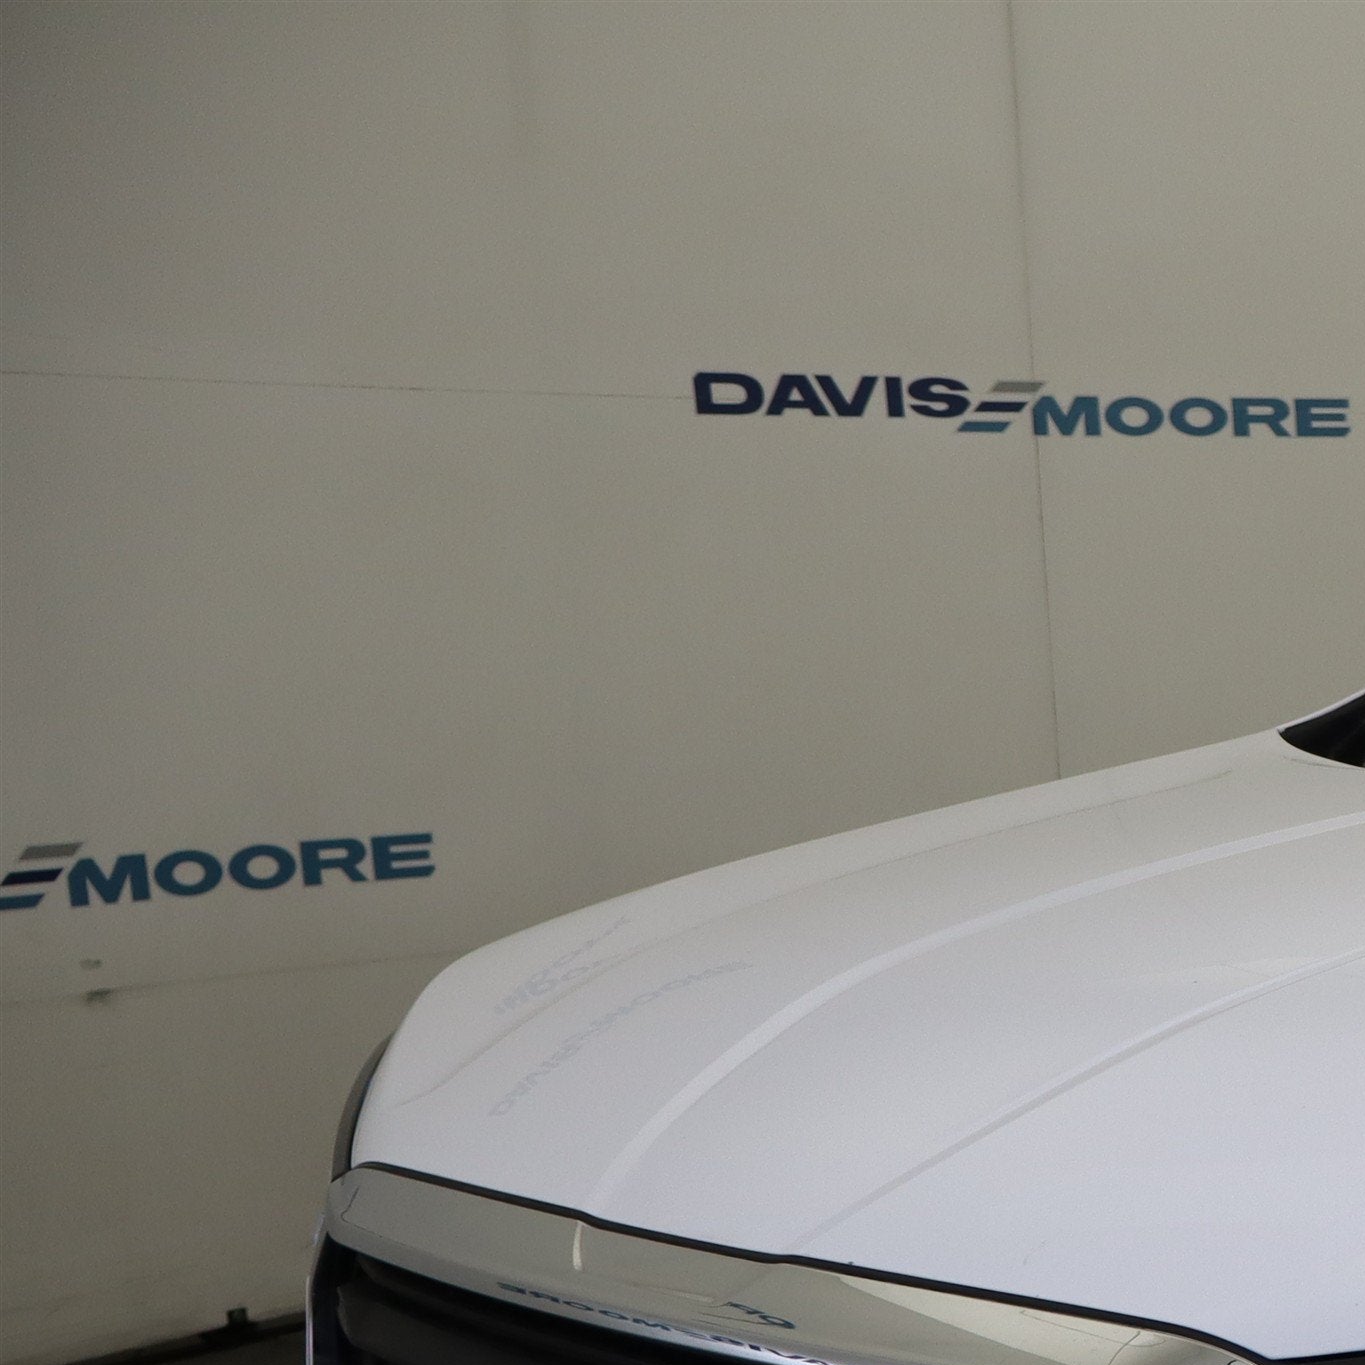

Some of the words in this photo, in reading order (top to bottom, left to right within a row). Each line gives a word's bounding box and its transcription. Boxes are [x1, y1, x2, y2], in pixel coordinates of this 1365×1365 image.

[692, 372, 972, 418] DAVIS
[1032, 396, 1351, 437] MOORE
[67, 833, 436, 907] MOORE
